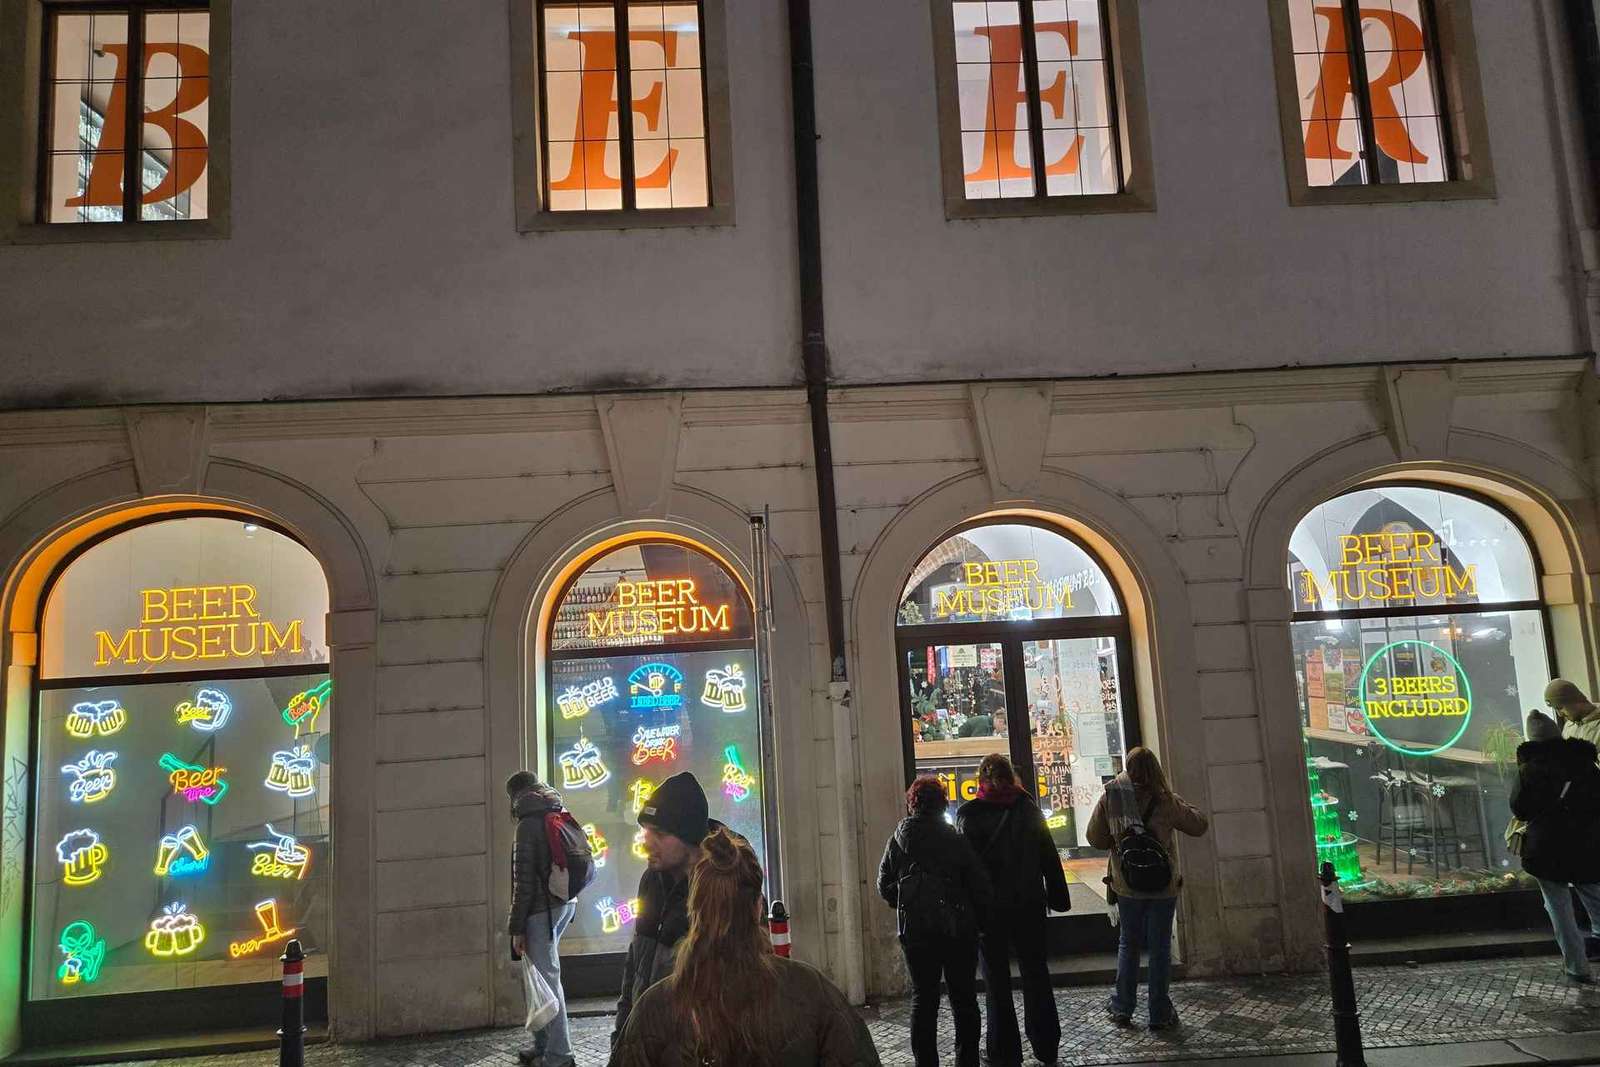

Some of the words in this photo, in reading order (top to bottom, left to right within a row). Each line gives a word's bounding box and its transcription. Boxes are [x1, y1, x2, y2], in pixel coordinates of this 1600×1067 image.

[1337, 530, 1440, 566] BEER
[963, 559, 1041, 587] BEER
[1302, 564, 1479, 603] MUSEUM
[140, 583, 259, 625] BEER
[617, 579, 698, 609] BEER
[937, 584, 1074, 617] MUSEUM
[587, 605, 730, 639] MUSEUM
[94, 619, 304, 666] MUSEUM
[582, 677, 613, 697] COLD
[586, 685, 619, 707] BEER
[1374, 678, 1388, 695] 3
[1391, 675, 1457, 695] BEERS
[176, 702, 213, 720] Beer
[1365, 697, 1469, 718] INCLUDED
[70, 770, 113, 801] Beer
[169, 766, 226, 793] Beer
[251, 853, 296, 878] Beer
[230, 940, 263, 957] Beer
